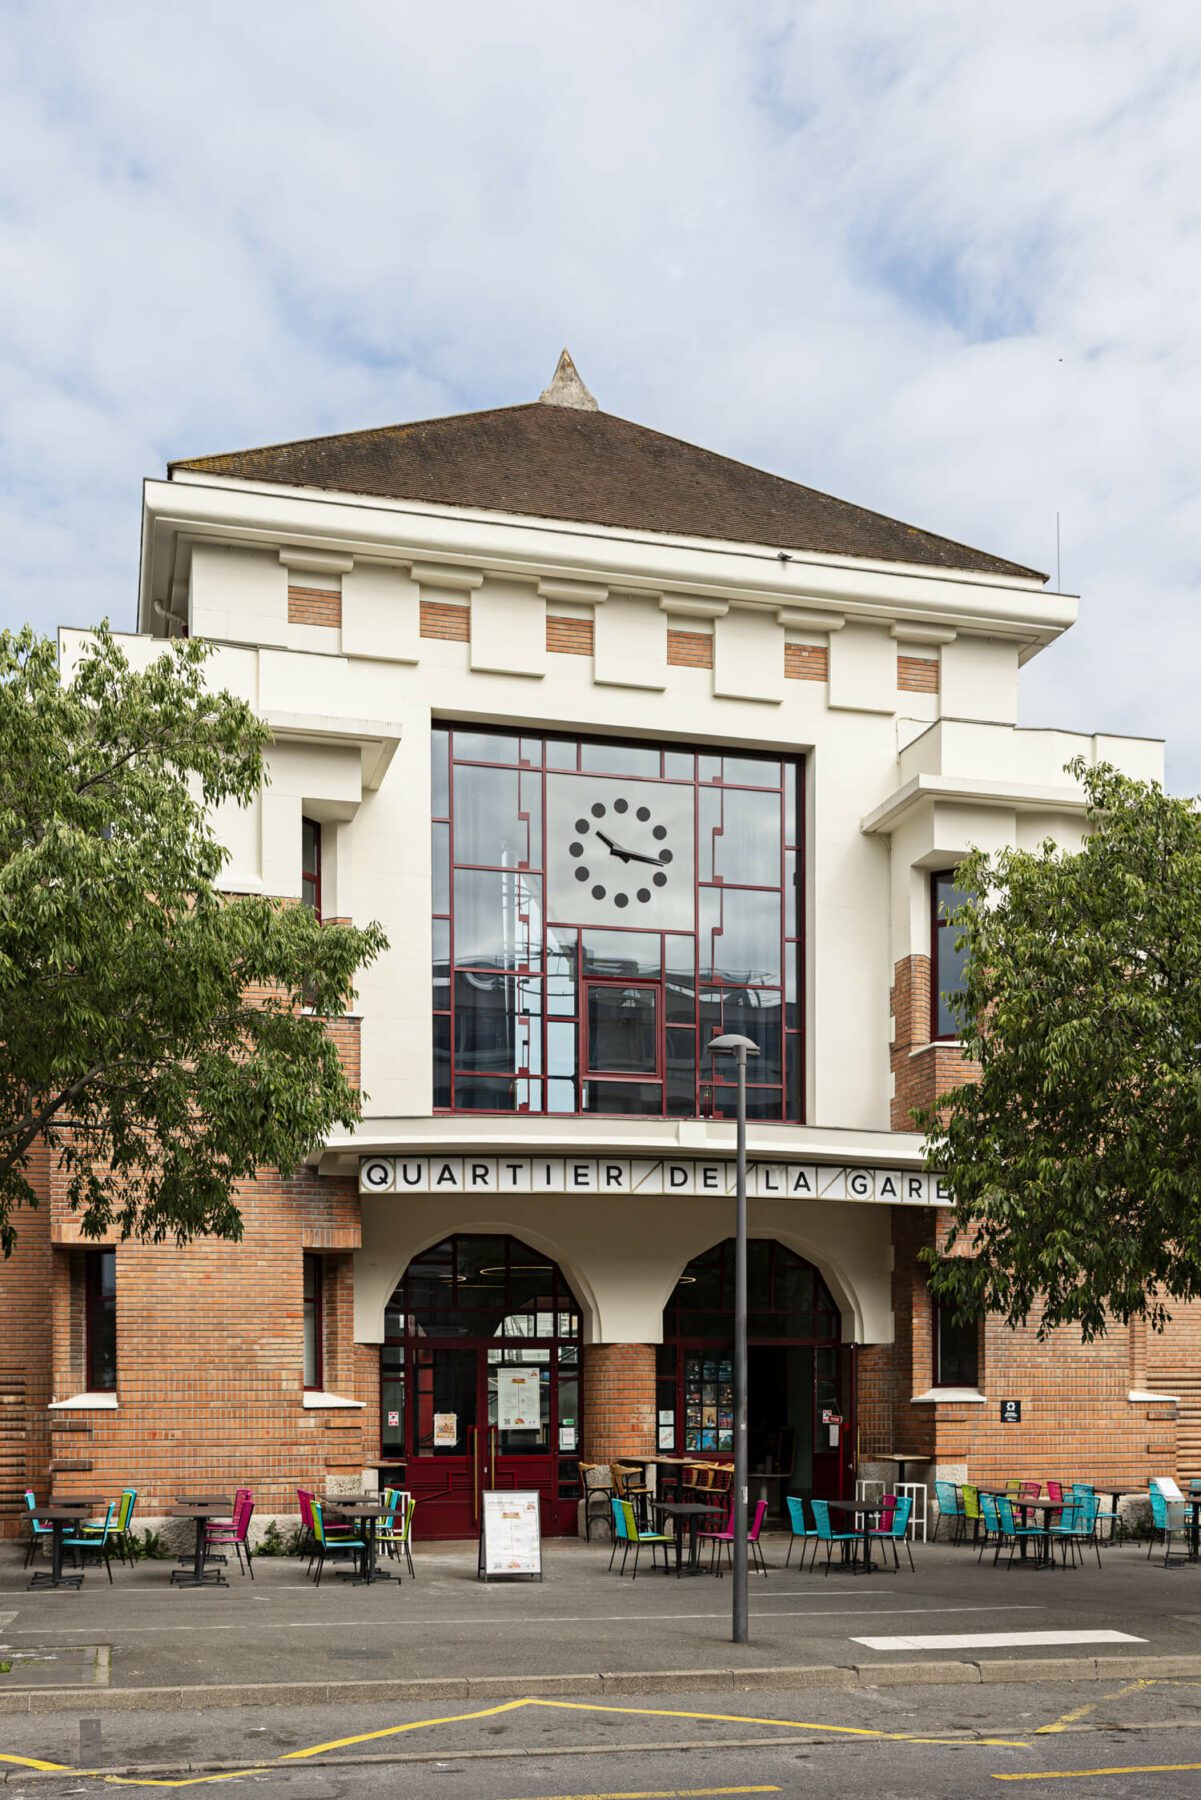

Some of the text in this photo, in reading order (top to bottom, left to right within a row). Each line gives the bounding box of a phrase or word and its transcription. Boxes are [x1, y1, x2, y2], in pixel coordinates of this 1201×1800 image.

[366, 1164, 952, 1200] QUARTIER DE LA GARE
